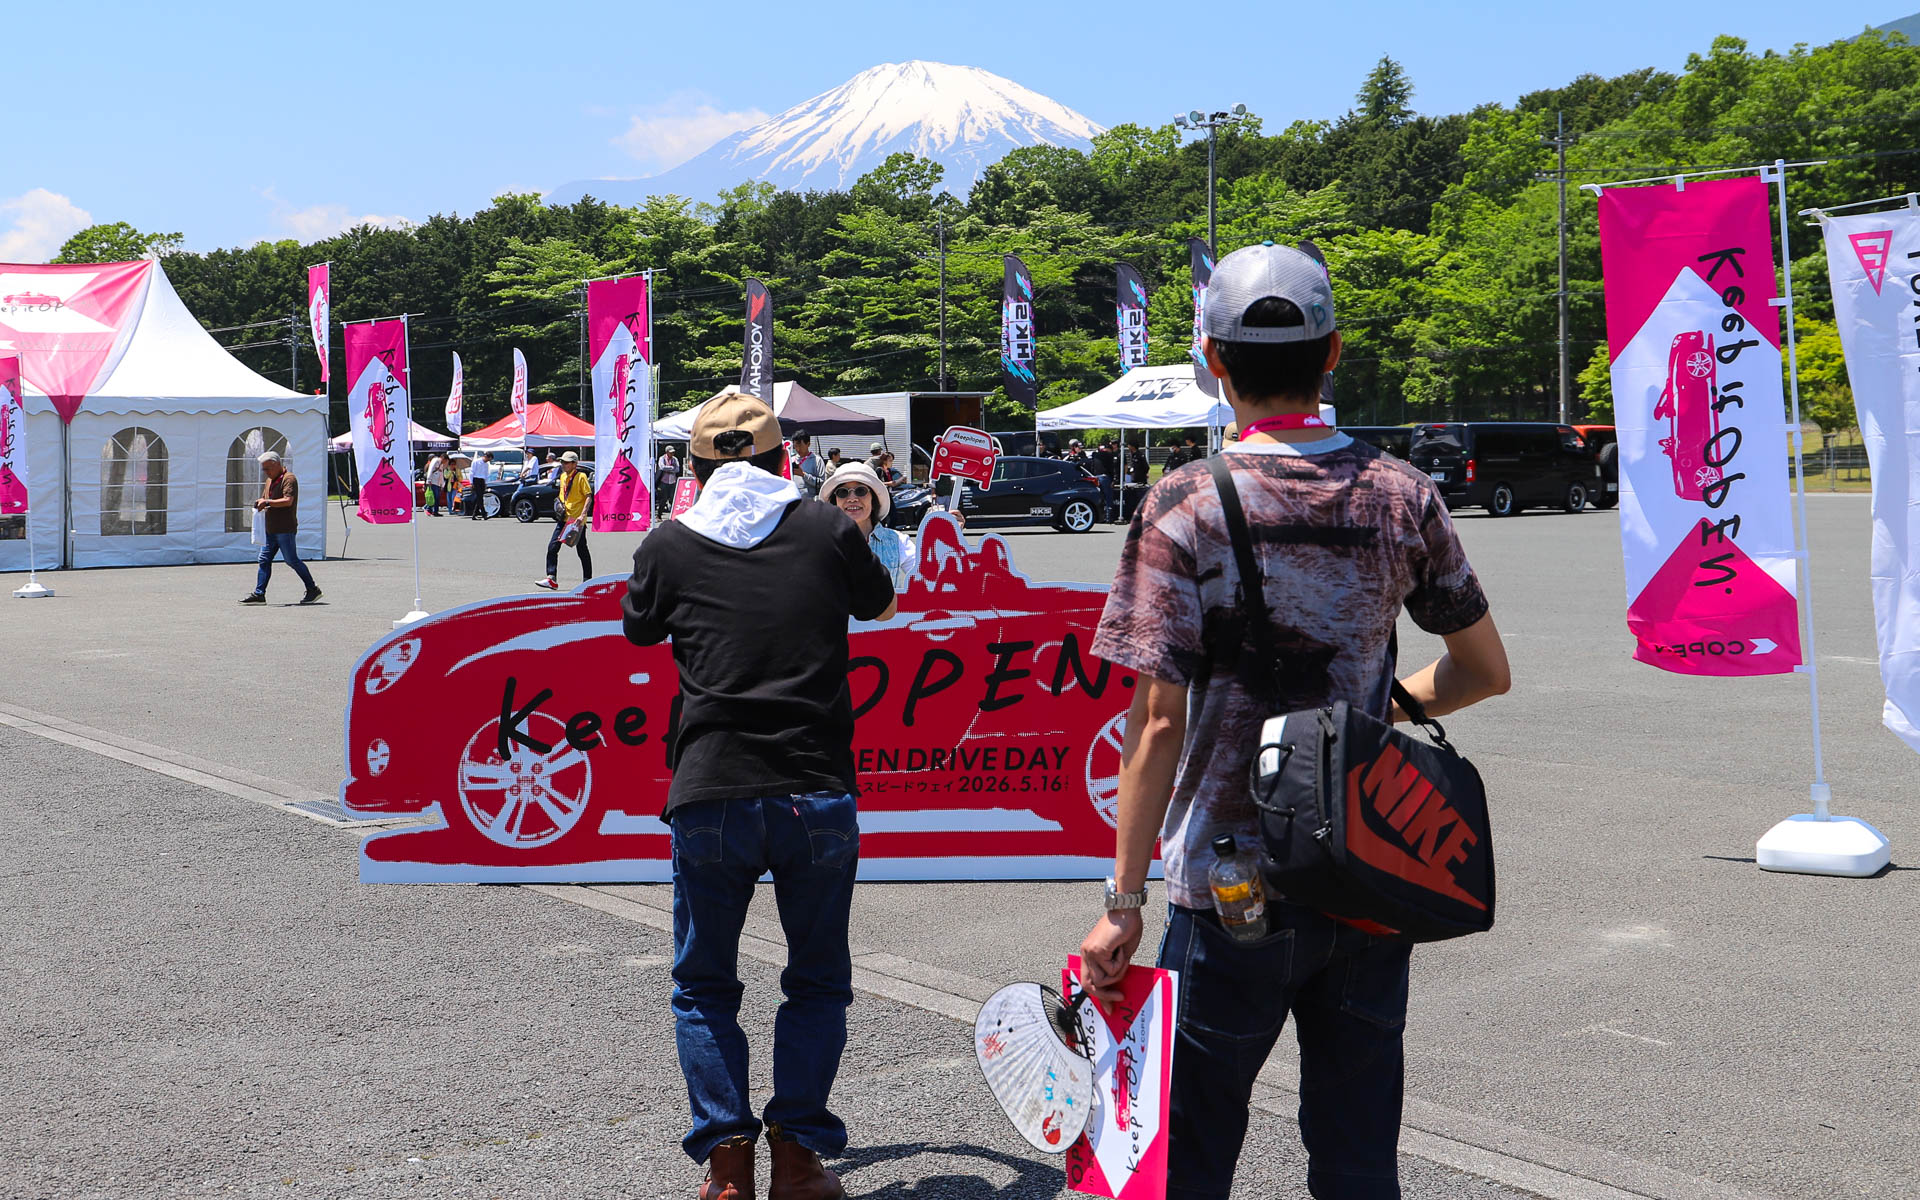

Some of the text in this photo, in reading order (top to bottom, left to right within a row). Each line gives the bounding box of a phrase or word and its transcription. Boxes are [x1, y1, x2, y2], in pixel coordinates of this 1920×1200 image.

[1117, 378, 1195, 402] HKS
[1030, 507, 1052, 516] HKS
[906, 747, 998, 772] DRIVE
[1004, 746, 1070, 771] DAY
[958, 775, 1062, 793] 2026.5.16
[1362, 742, 1479, 876] NIKE
[1119, 1001, 1143, 1174] Keep it OPEN.
